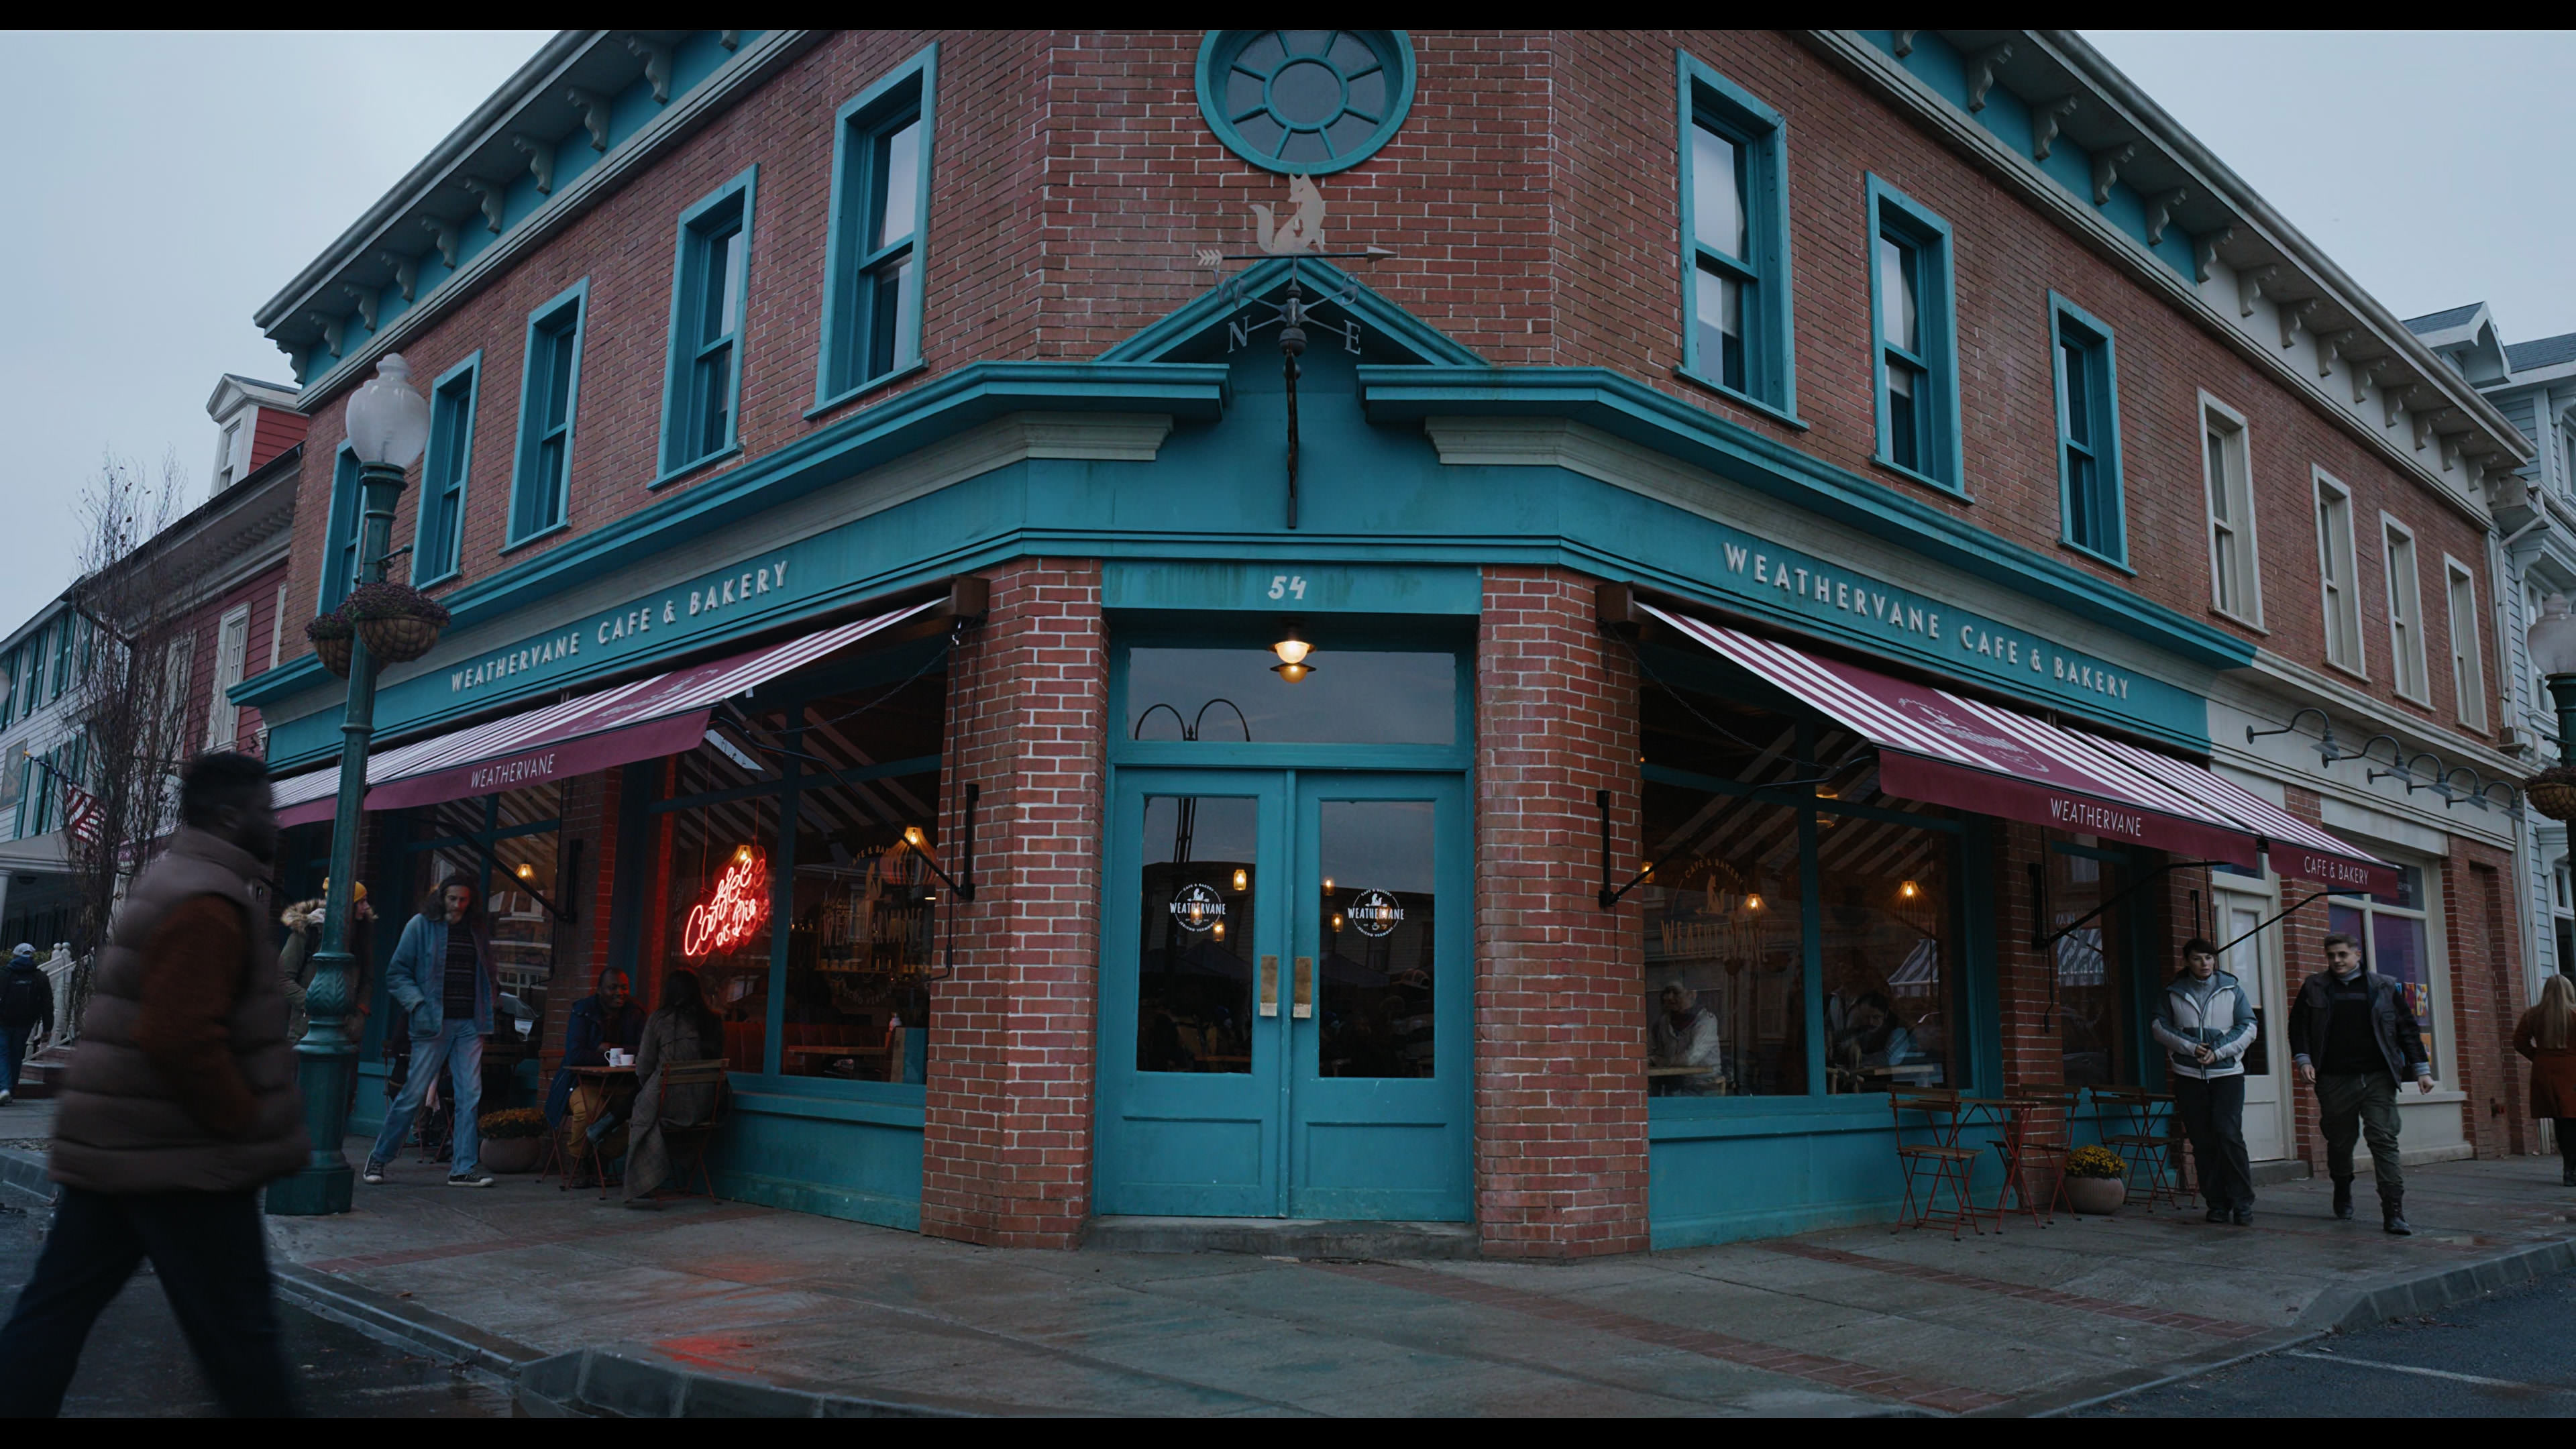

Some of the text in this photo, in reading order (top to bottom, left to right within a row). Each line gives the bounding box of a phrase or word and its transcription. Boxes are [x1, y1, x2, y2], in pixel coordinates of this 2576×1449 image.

[1227, 315, 1251, 354] N
[1344, 319, 1361, 356] E
[1267, 575, 1307, 600] 54
[451, 560, 789, 692] WEATHERVANE CAFE & BAKERY
[1722, 541, 2129, 700] WEATHERVANE CAFE & BAKERY
[470, 753, 556, 789] WEATHERVANE
[2050, 797, 2142, 837] WEATHERVANE
[1684, 859, 1705, 879] CAFE
[2304, 855, 2369, 885] CAFE & BAKERY
[1169, 902, 1226, 915] WEATHERVANE
[1347, 907, 1405, 920] WEATHERVANE
[823, 906, 924, 948] WEARVANE
